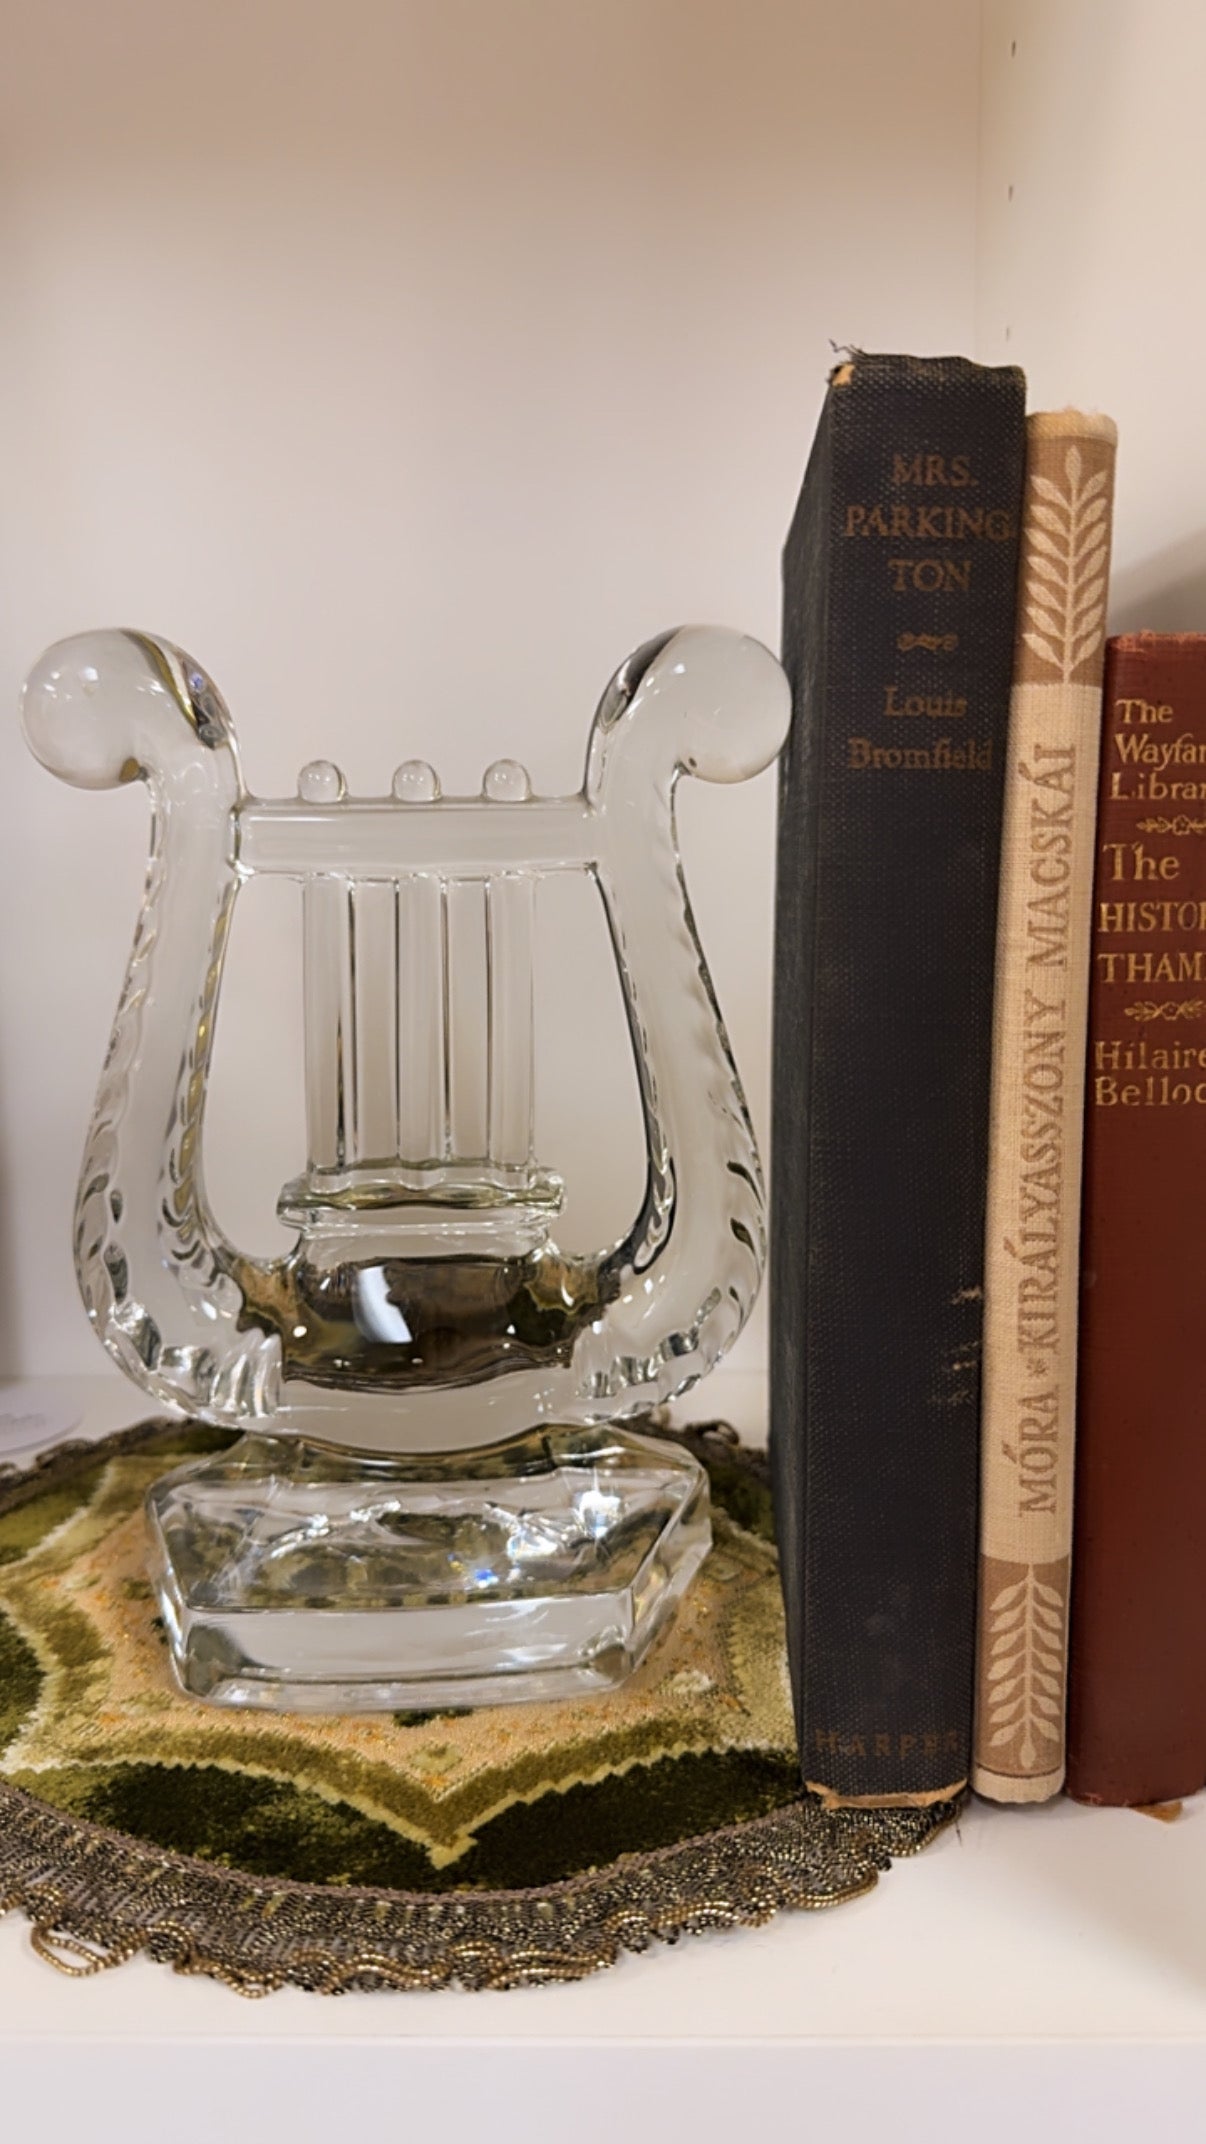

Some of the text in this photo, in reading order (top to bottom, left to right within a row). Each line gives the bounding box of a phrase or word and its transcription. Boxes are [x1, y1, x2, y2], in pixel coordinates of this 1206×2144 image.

[890, 453, 979, 487] MRS.
[887, 558, 973, 592] TON
[883, 685, 968, 719] Louis
[1115, 698, 1174, 724] The
[848, 736, 994, 771] Bromfield
[1102, 841, 1180, 881] The
[1096, 952, 1206, 983] THAM
[1094, 1075, 1206, 1107] Belloc
[1001, 743, 1077, 1517] MÓRA KIRÁLYASSZONY MACSKÁI
